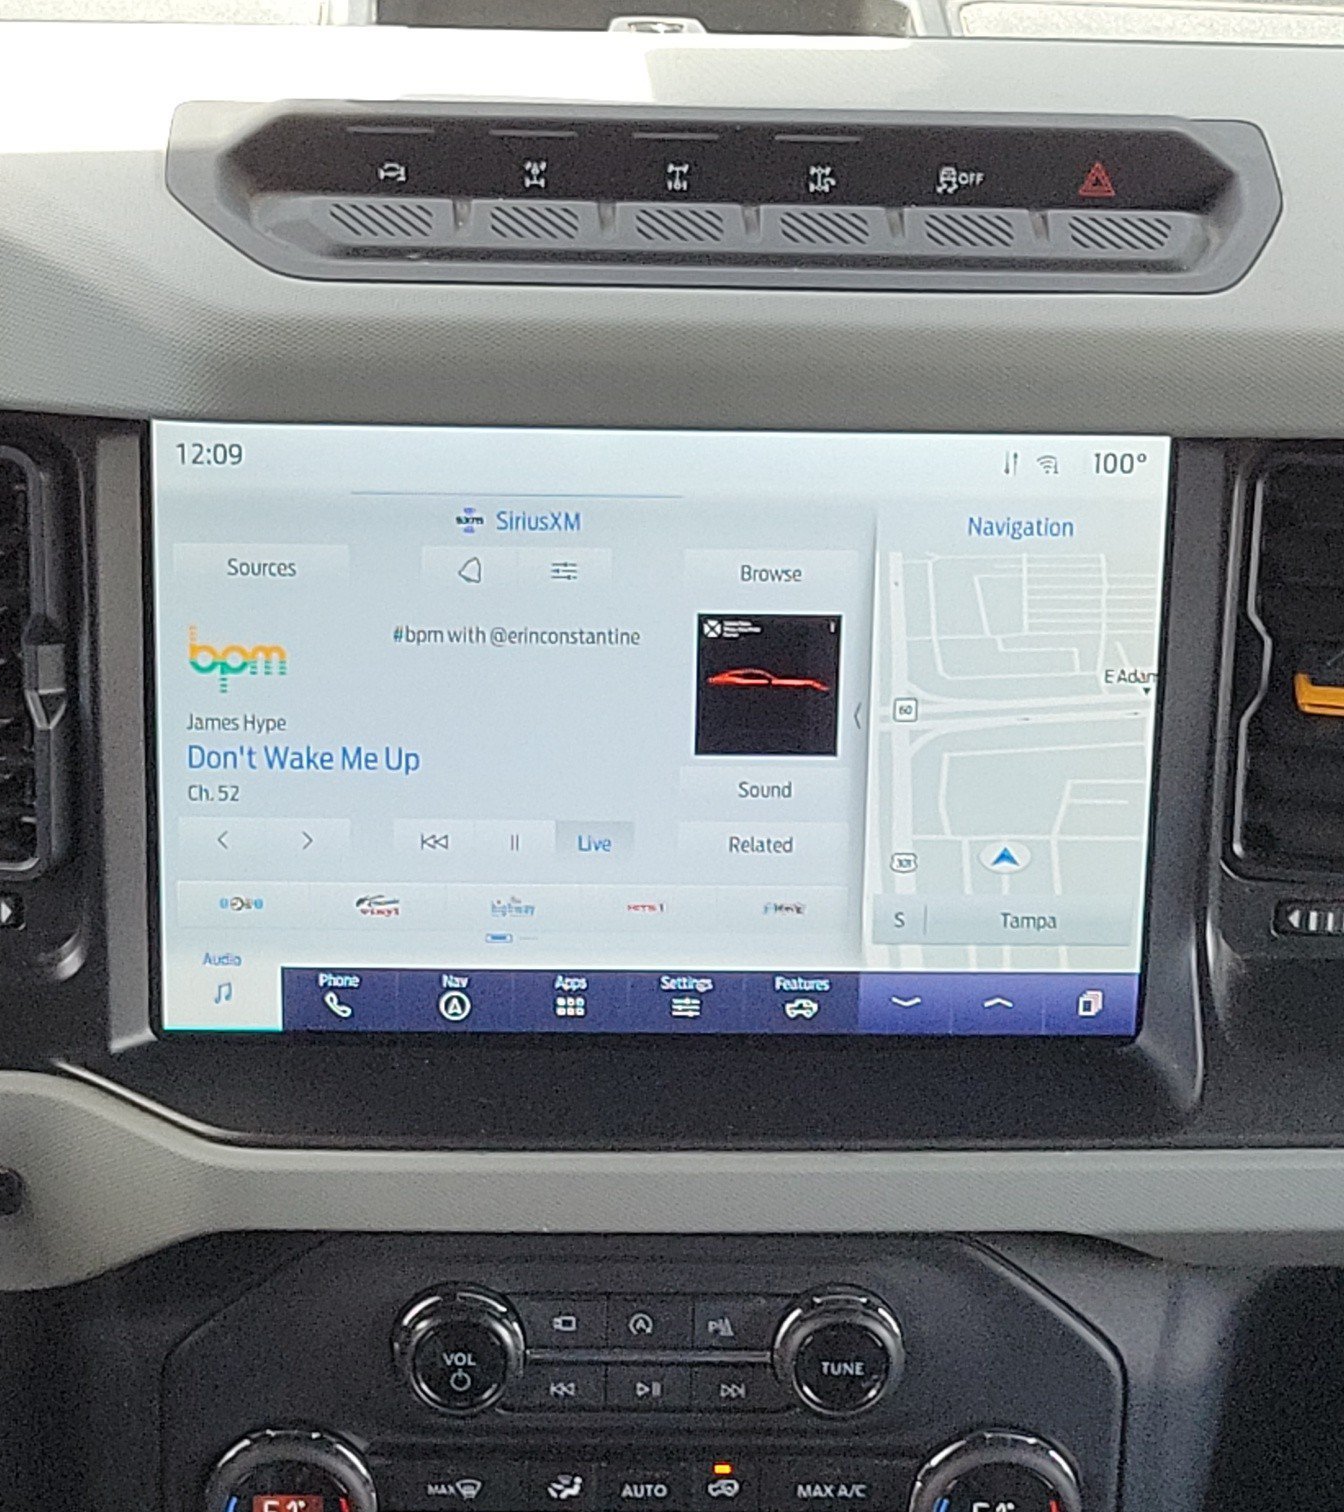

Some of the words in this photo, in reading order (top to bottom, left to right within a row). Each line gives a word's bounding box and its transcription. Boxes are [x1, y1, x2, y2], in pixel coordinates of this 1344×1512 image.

[958, 171, 984, 186] OFF
[176, 443, 244, 467] 12:09
[1094, 452, 1148, 475] 100°
[496, 510, 581, 532] SiriusXM
[967, 516, 1074, 540] Navigation
[227, 557, 297, 579] Sources
[740, 564, 803, 583] Browse
[393, 625, 444, 647] #bpm
[447, 625, 486, 645] with
[489, 625, 641, 648] @erinconstantine
[188, 623, 288, 694] bpm
[1105, 669, 1115, 684] E
[187, 714, 239, 732] James
[244, 714, 287, 734] Hype
[187, 745, 256, 771] Don't
[263, 746, 334, 771] Wake
[341, 747, 378, 771] Me
[384, 747, 420, 775] Up
[187, 785, 214, 802] Ch.
[218, 785, 240, 802] 52
[738, 781, 792, 799] Sound
[578, 834, 612, 853] Live
[729, 836, 793, 854] Related
[894, 911, 905, 928] S
[1001, 912, 1057, 934] Tampa
[202, 952, 242, 967] Audio
[318, 973, 360, 989] Phone
[442, 973, 468, 988] Nav
[555, 975, 587, 992] Apps
[660, 975, 713, 993] Settings
[774, 976, 830, 992] Features
[443, 1353, 476, 1367] VOL
[821, 1362, 864, 1376] TUNE
[427, 1484, 454, 1496] MAX
[621, 1483, 667, 1498] AUTO
[797, 1484, 834, 1498] MAX
[836, 1484, 867, 1498] A/C
